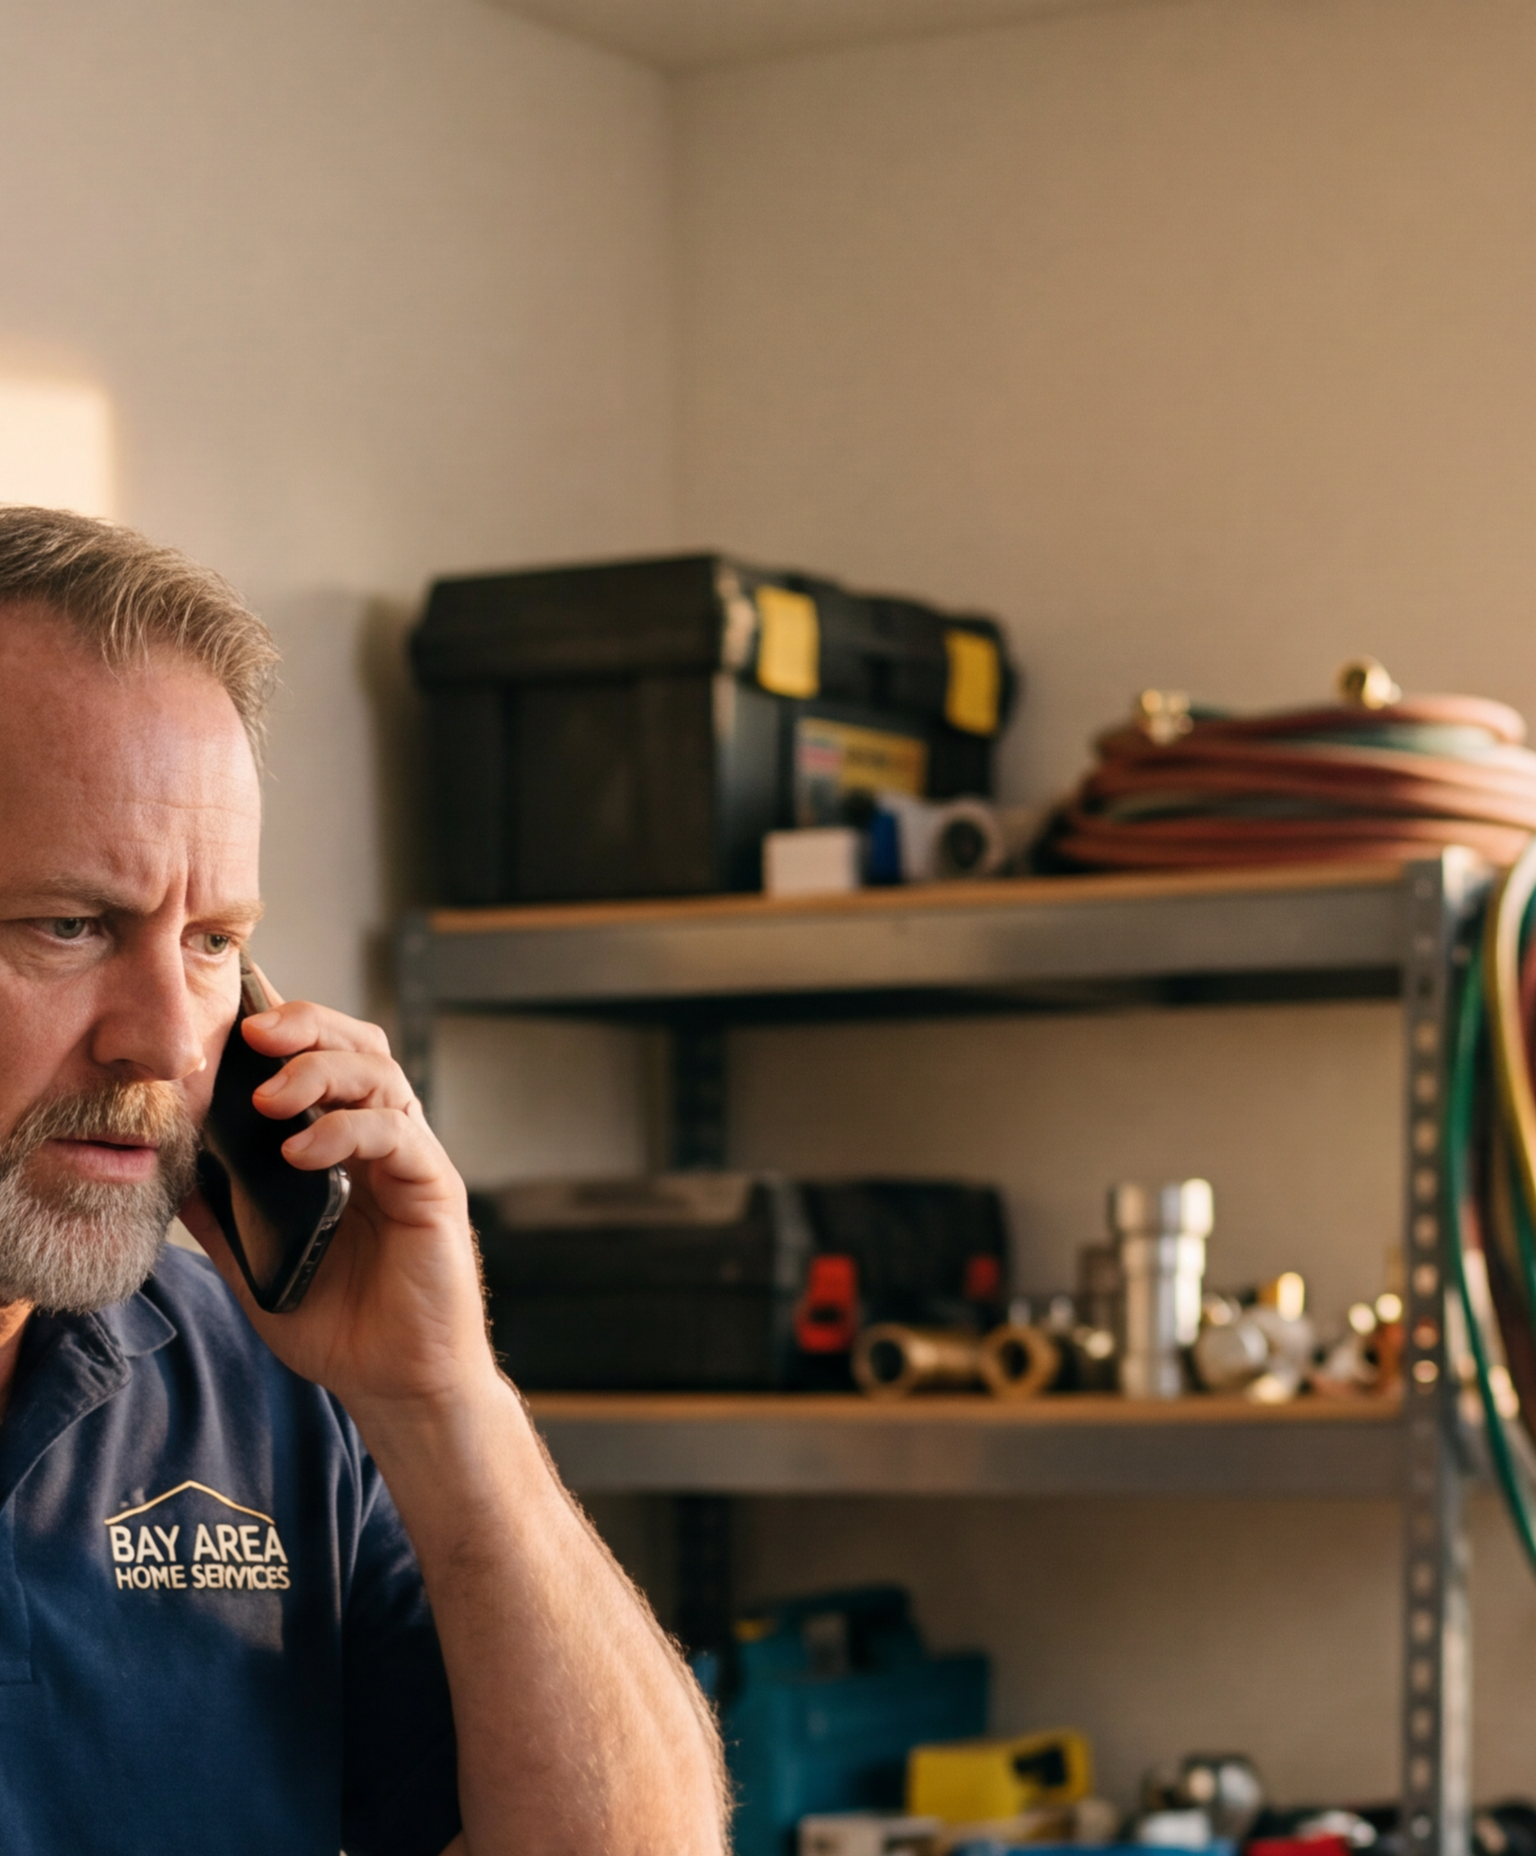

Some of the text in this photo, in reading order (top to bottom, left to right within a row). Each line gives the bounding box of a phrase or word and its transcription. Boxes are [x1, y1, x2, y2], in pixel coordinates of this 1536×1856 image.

[109, 1523, 289, 1564] BAY AREA
[115, 1565, 188, 1590] HOME
